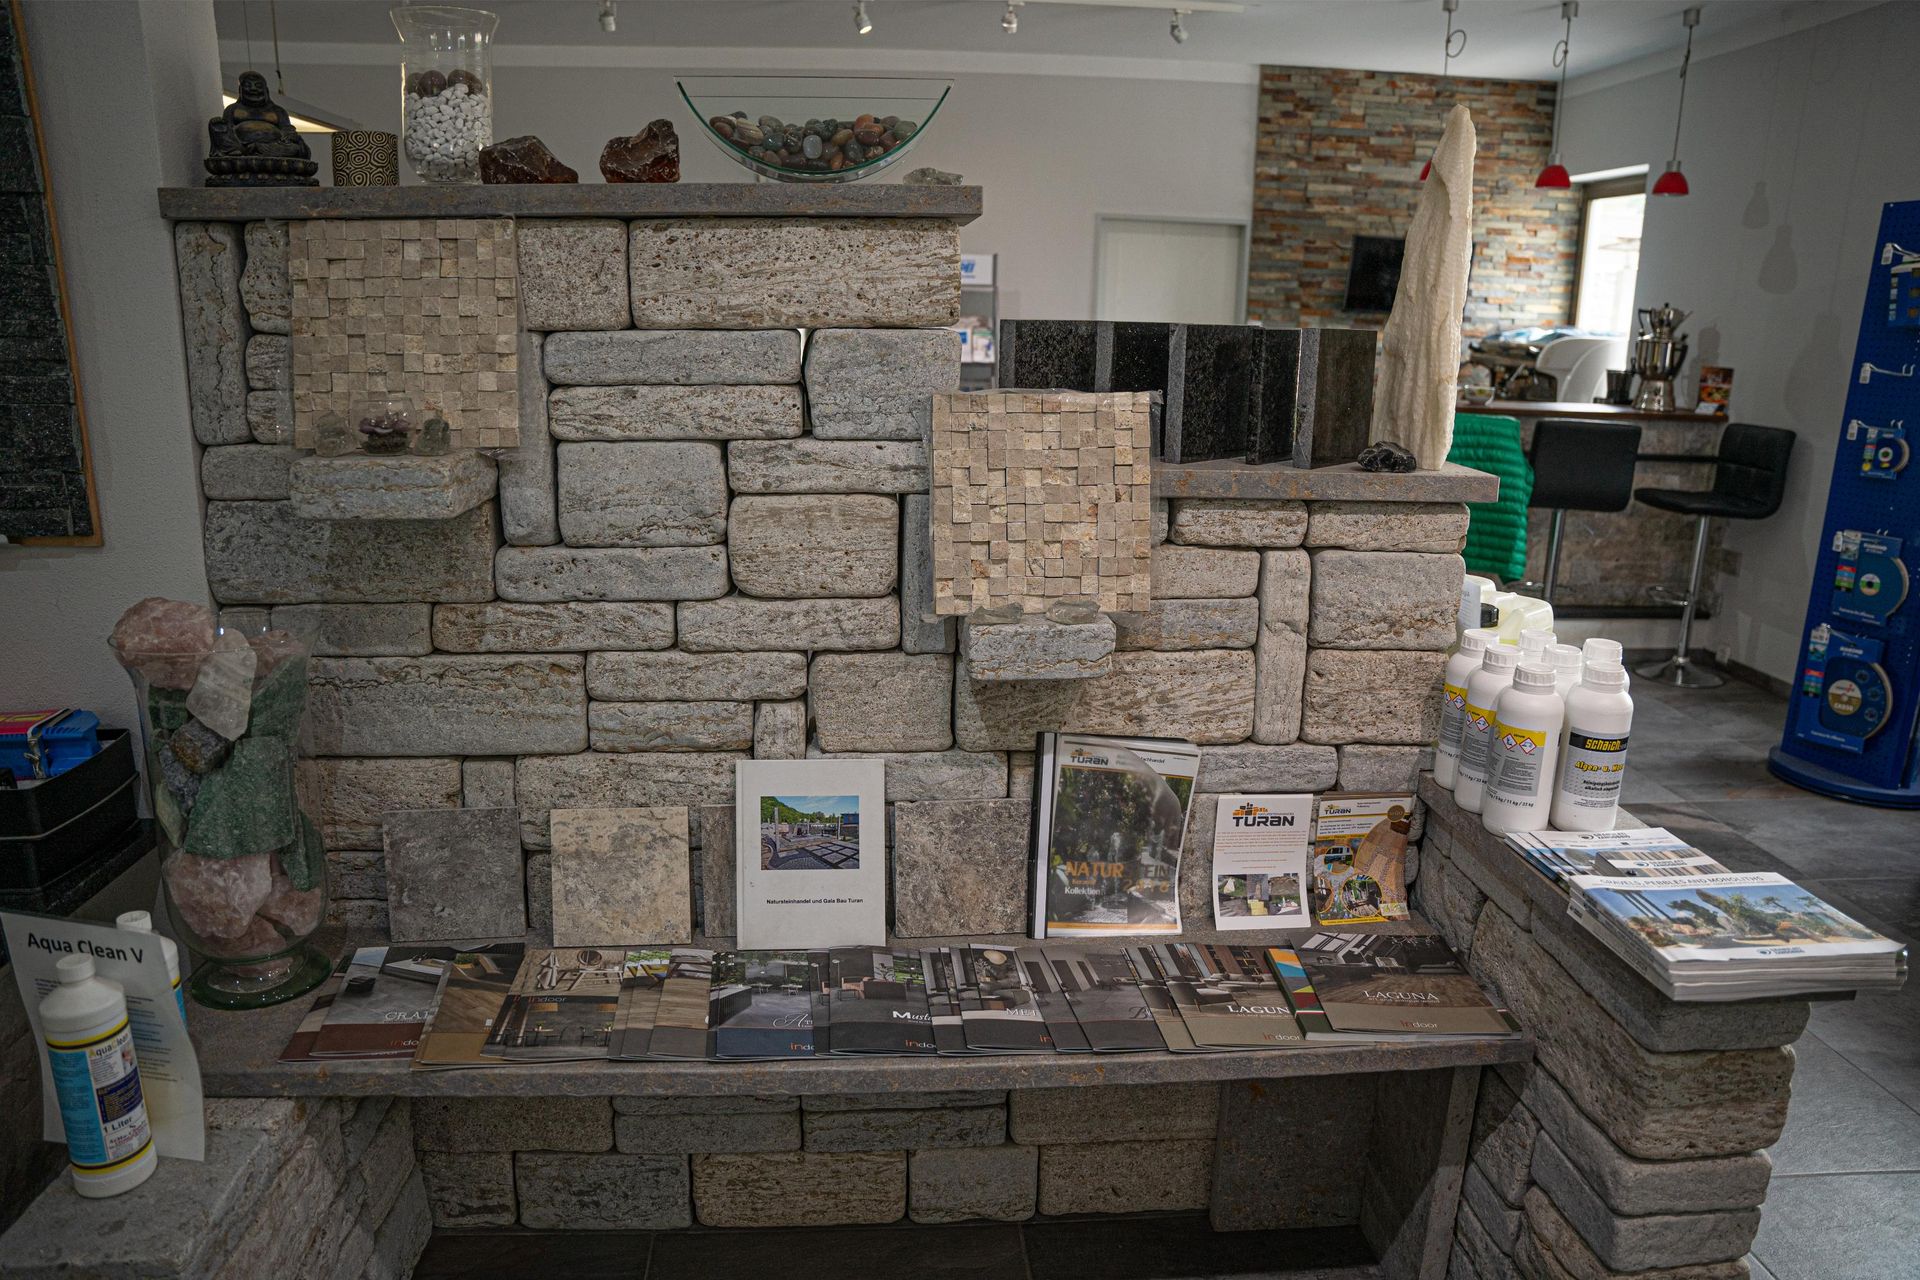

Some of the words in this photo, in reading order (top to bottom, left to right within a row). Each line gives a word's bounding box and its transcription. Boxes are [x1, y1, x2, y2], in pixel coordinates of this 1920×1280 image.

[28, 932, 73, 954] Aqua
[78, 940, 127, 961] Clean
[130, 947, 143, 964] V
[1363, 990, 1439, 1000] LAGUNA
[112, 1116, 133, 1131] Liter
